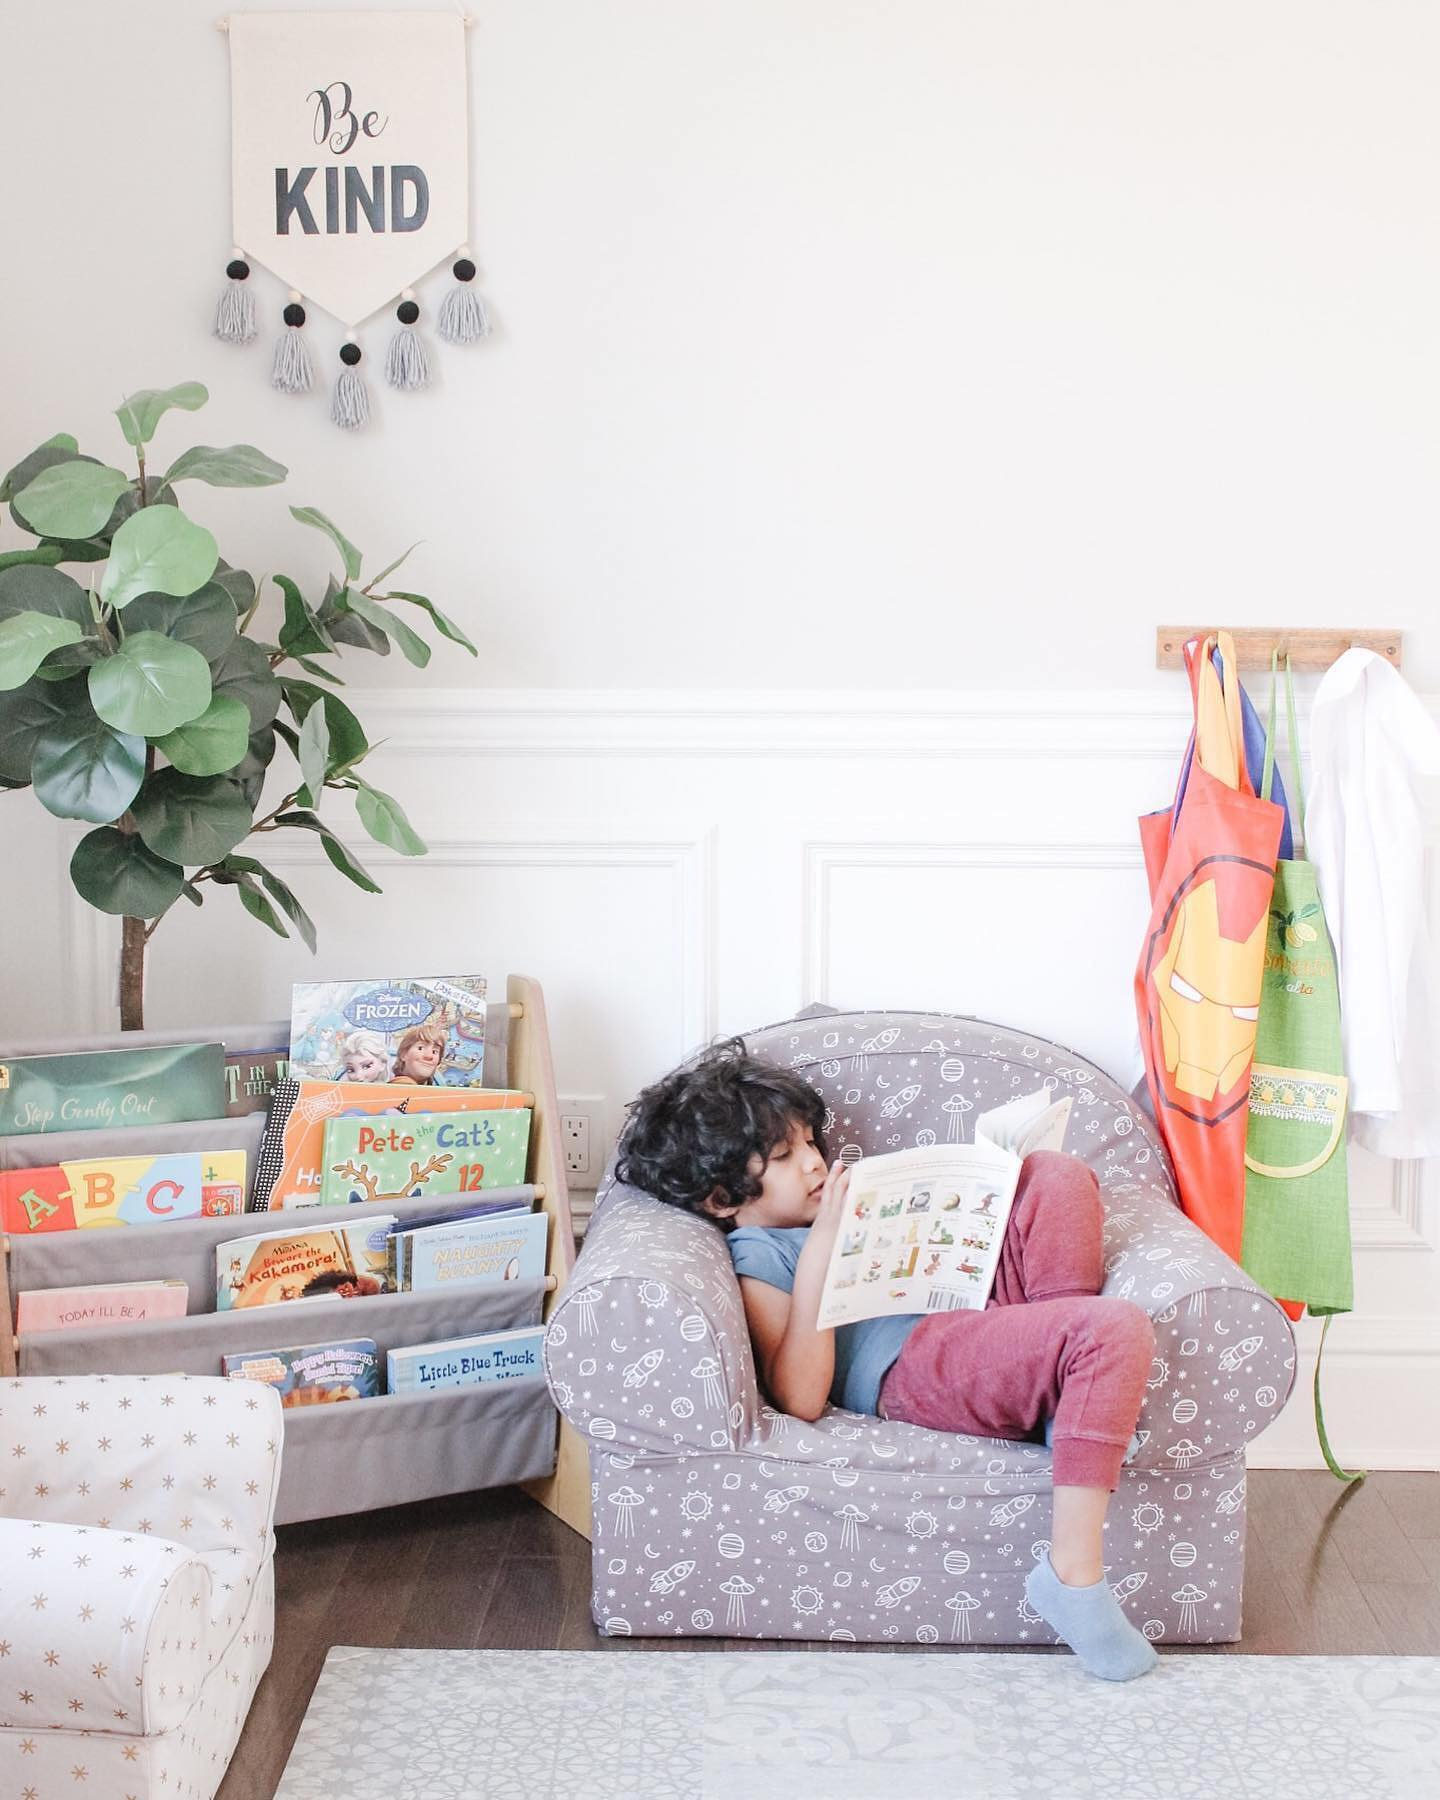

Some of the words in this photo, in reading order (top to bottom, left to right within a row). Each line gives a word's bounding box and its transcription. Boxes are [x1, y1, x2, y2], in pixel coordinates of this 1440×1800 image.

[306, 81, 390, 155] Be
[274, 165, 430, 236] KIND
[355, 1002, 421, 1020] FROZEN
[249, 1065, 265, 1080] IN
[243, 1080, 272, 1096] THE
[14, 1101, 55, 1134] Step
[61, 1097, 116, 1126] Gently
[121, 1093, 156, 1116] Out
[358, 1127, 415, 1154] Pete
[416, 1125, 435, 1138] the
[436, 1120, 496, 1148] Cat's
[458, 1163, 484, 1193] 12
[263, 1252, 302, 1269] Beware
[306, 1247, 322, 1259] the
[432, 1239, 528, 1264] NAUGHTY
[249, 1251, 338, 1284] Kakamora!
[436, 1258, 507, 1281] BUNNY
[59, 1307, 96, 1325] TODAY
[120, 1305, 135, 1318] BE
[138, 1308, 146, 1320] A
[291, 1353, 325, 1373] Happy
[419, 1362, 458, 1383] Little
[461, 1357, 491, 1375] Blue
[493, 1350, 535, 1368] Truck
